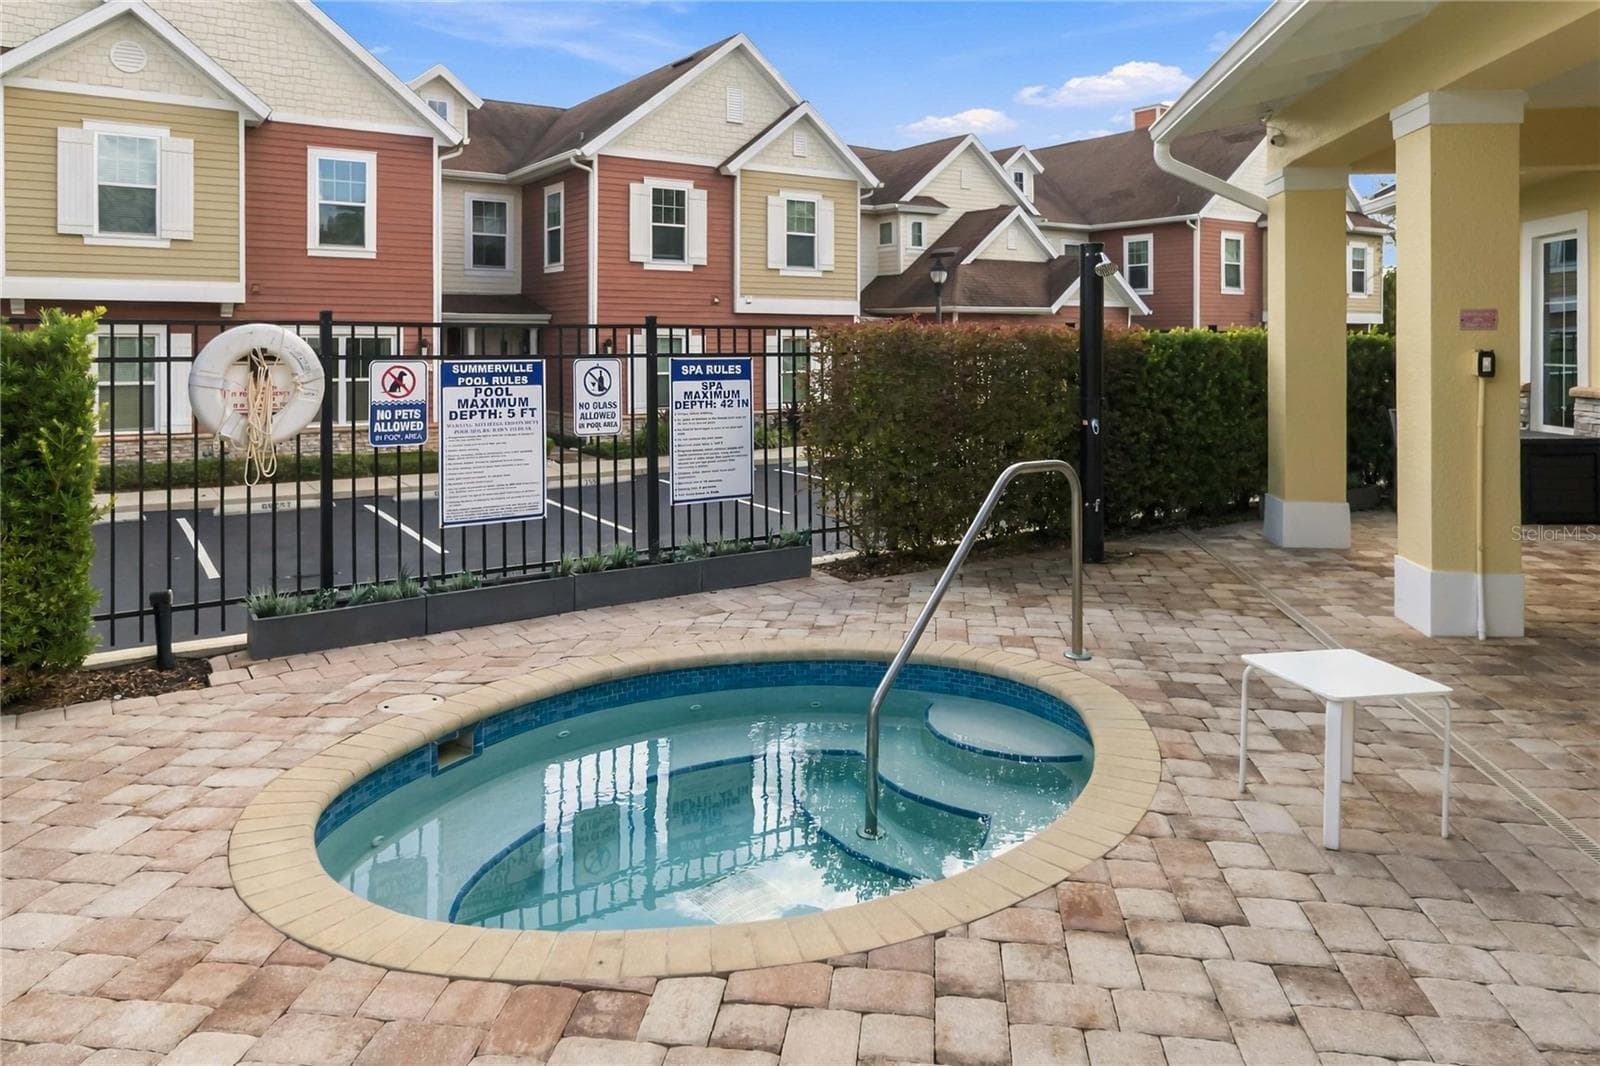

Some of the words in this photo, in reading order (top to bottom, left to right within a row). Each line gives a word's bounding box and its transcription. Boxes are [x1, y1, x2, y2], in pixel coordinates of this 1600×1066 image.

[452, 364, 534, 374] SUMMERVILLE
[681, 365, 703, 375] SPA
[706, 365, 742, 375] RULES
[457, 377, 489, 386] POOL
[492, 376, 529, 385] RULES
[701, 382, 723, 391] SPA
[474, 387, 513, 398] POOL
[684, 390, 740, 400] MAXIMUM
[457, 398, 529, 409] MAXIMUM
[579, 402, 590, 410] NO
[592, 401, 618, 410] GLASS
[674, 400, 717, 410] DEPTH:
[720, 400, 734, 408] 42
[737, 399, 749, 408] IN
[376, 409, 392, 420] NO
[394, 409, 421, 420] PETS
[449, 410, 502, 421] DEPTH:
[507, 409, 516, 418] 5
[520, 408, 537, 418] FT
[580, 411, 616, 420] ALLOWED
[373, 421, 424, 433] ALLOWED
[404, 433, 423, 441] AREA
